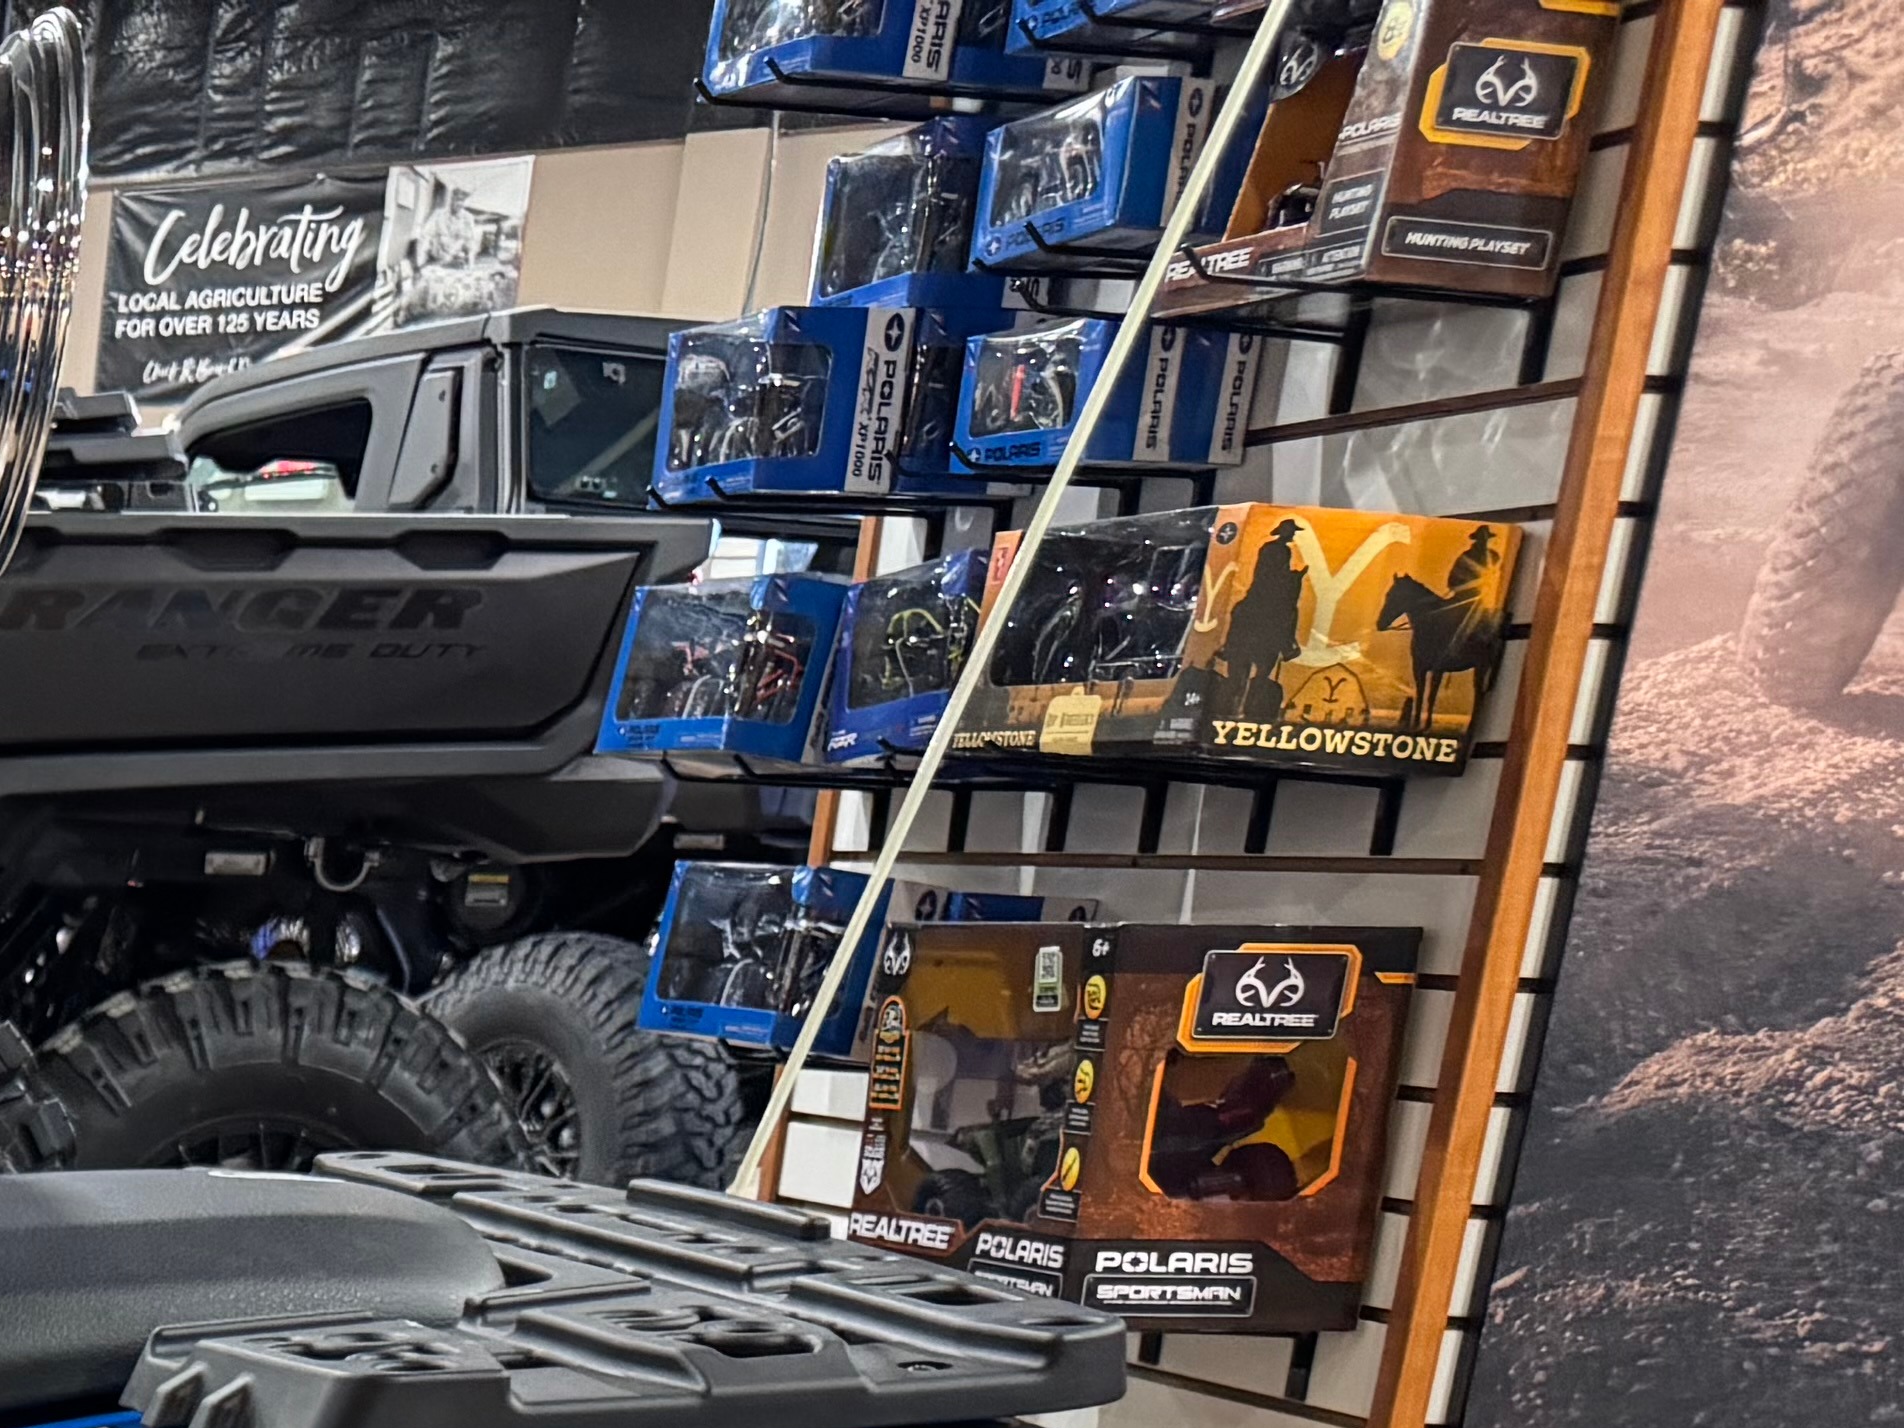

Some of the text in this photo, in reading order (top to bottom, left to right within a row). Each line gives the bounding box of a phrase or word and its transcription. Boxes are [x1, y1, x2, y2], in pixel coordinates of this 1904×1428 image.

[1338, 112, 1402, 139] POLARIS
[1452, 108, 1549, 130] REALTREE
[144, 203, 365, 292] Celebrating
[1405, 231, 1532, 256] HUNTING PLAYSET
[117, 282, 324, 313] LOCAL AGRICULTURE
[115, 309, 320, 338] FOR OVER 125 YEARS
[1146, 358, 1168, 449] POLARIS
[1222, 361, 1248, 451] POLARIS
[868, 359, 897, 482] POLARIS
[852, 422, 869, 477] XP1000
[984, 442, 1041, 461] POLARIS
[368, 642, 490, 660] DUTY
[1212, 721, 1458, 763] YELLOWSTONE
[1092, 938, 1110, 957] 6+
[1212, 1013, 1319, 1028] REALTREE
[849, 1212, 955, 1250] REALTREE
[976, 1233, 1064, 1269] POLARIS
[1095, 1252, 1253, 1275] POLARIS
[1096, 1285, 1242, 1301] SPORTSMAN
